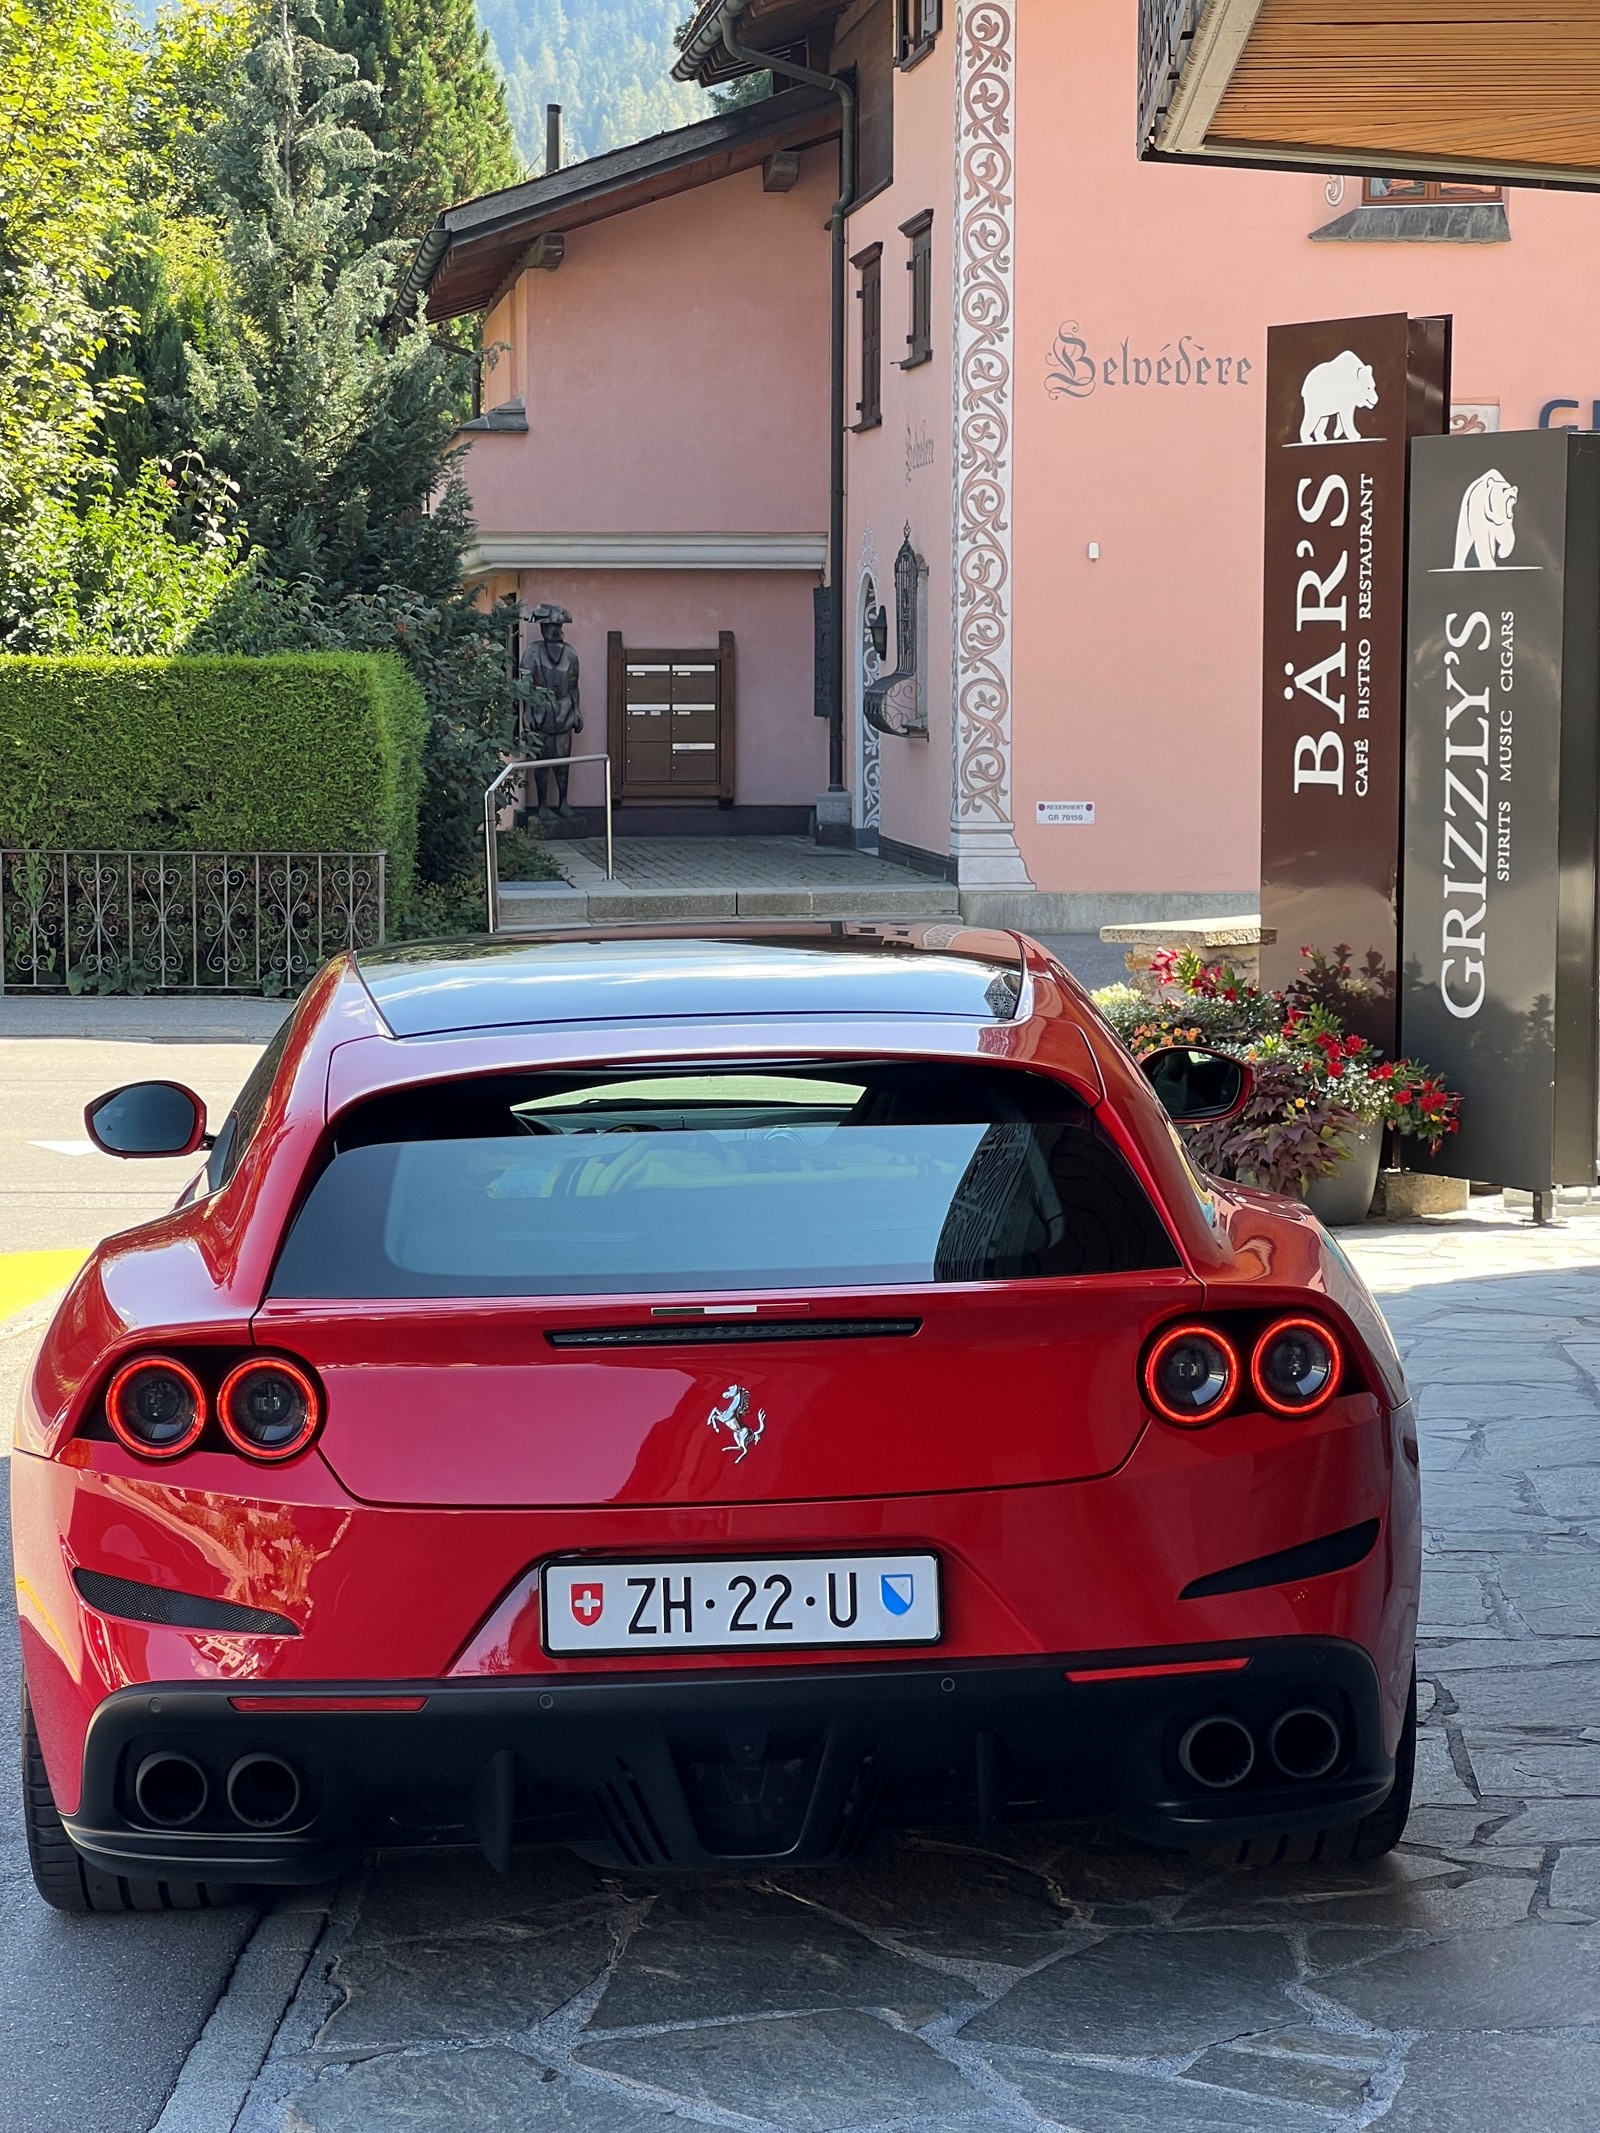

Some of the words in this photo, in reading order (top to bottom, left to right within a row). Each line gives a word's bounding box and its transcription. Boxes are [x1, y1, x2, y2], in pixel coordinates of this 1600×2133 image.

[1044, 320, 1252, 401] Belvédère
[1358, 473, 1374, 619] RESTAURANT
[1284, 473, 1349, 796] BÄR'S
[1500, 611, 1515, 692] CIGARS
[1357, 638, 1371, 720] BISTRO
[1354, 737, 1370, 797] CAFÉ
[1499, 710, 1513, 782] MUSIC
[1440, 611, 1492, 1019] GRIZZLY'S
[1497, 801, 1512, 882] SPIRITS
